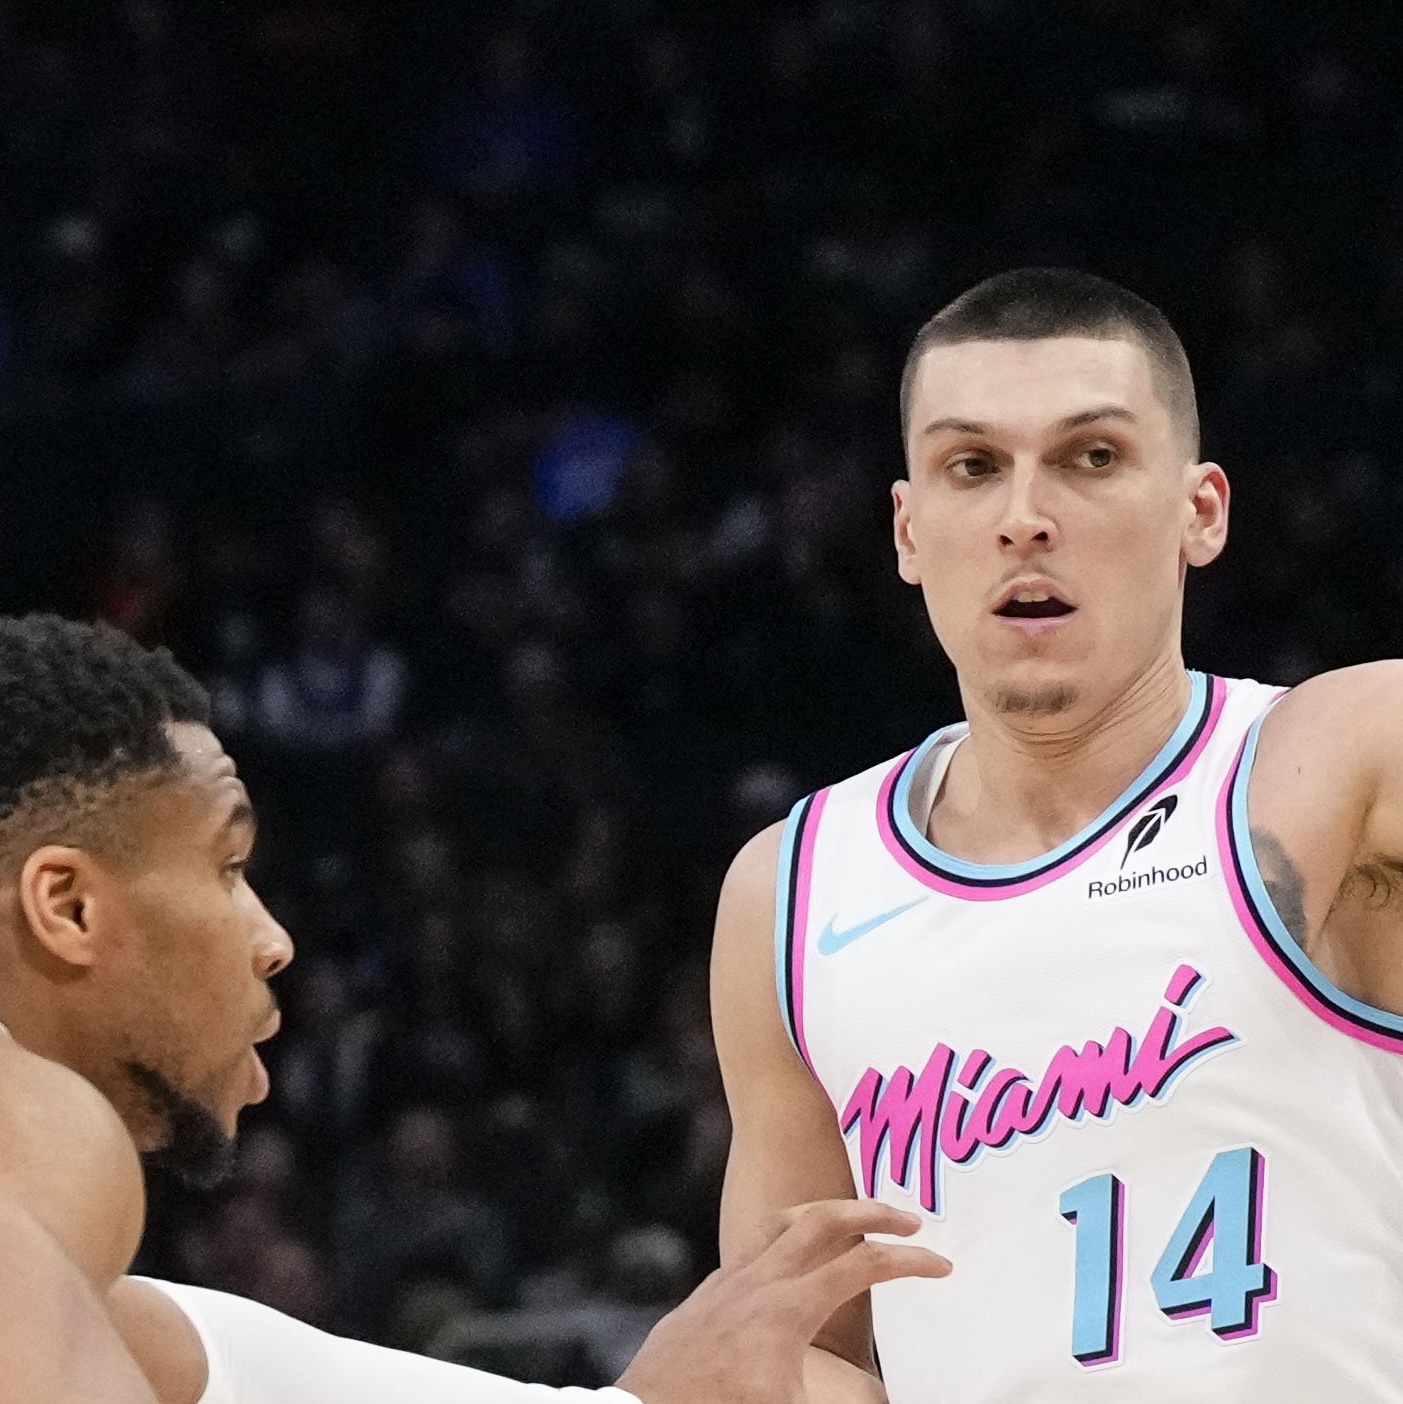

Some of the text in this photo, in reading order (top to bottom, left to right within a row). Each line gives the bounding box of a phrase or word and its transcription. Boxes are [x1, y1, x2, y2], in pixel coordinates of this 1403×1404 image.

[1087, 854, 1208, 900] Robinhood
[841, 963, 1238, 1216] Miami
[1059, 1146, 1278, 1368] 14
